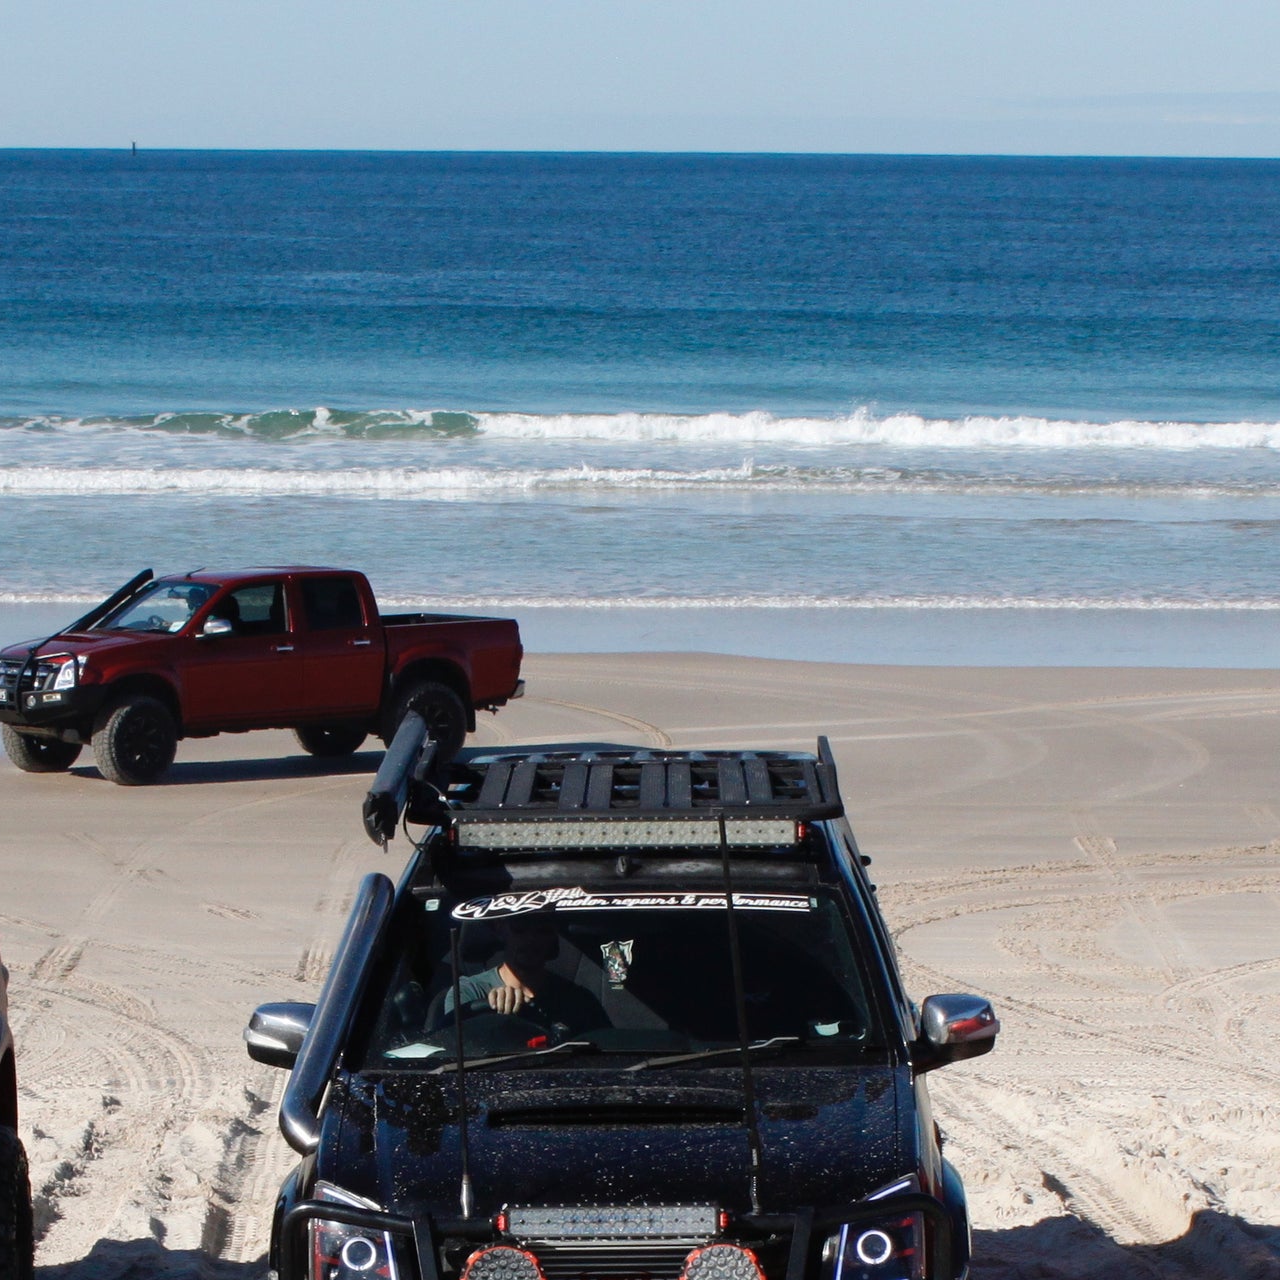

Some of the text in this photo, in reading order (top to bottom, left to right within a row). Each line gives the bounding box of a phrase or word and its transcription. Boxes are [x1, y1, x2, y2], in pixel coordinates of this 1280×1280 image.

[556, 895, 610, 907] motor
[611, 895, 679, 907] repairs
[681, 894, 696, 905] &
